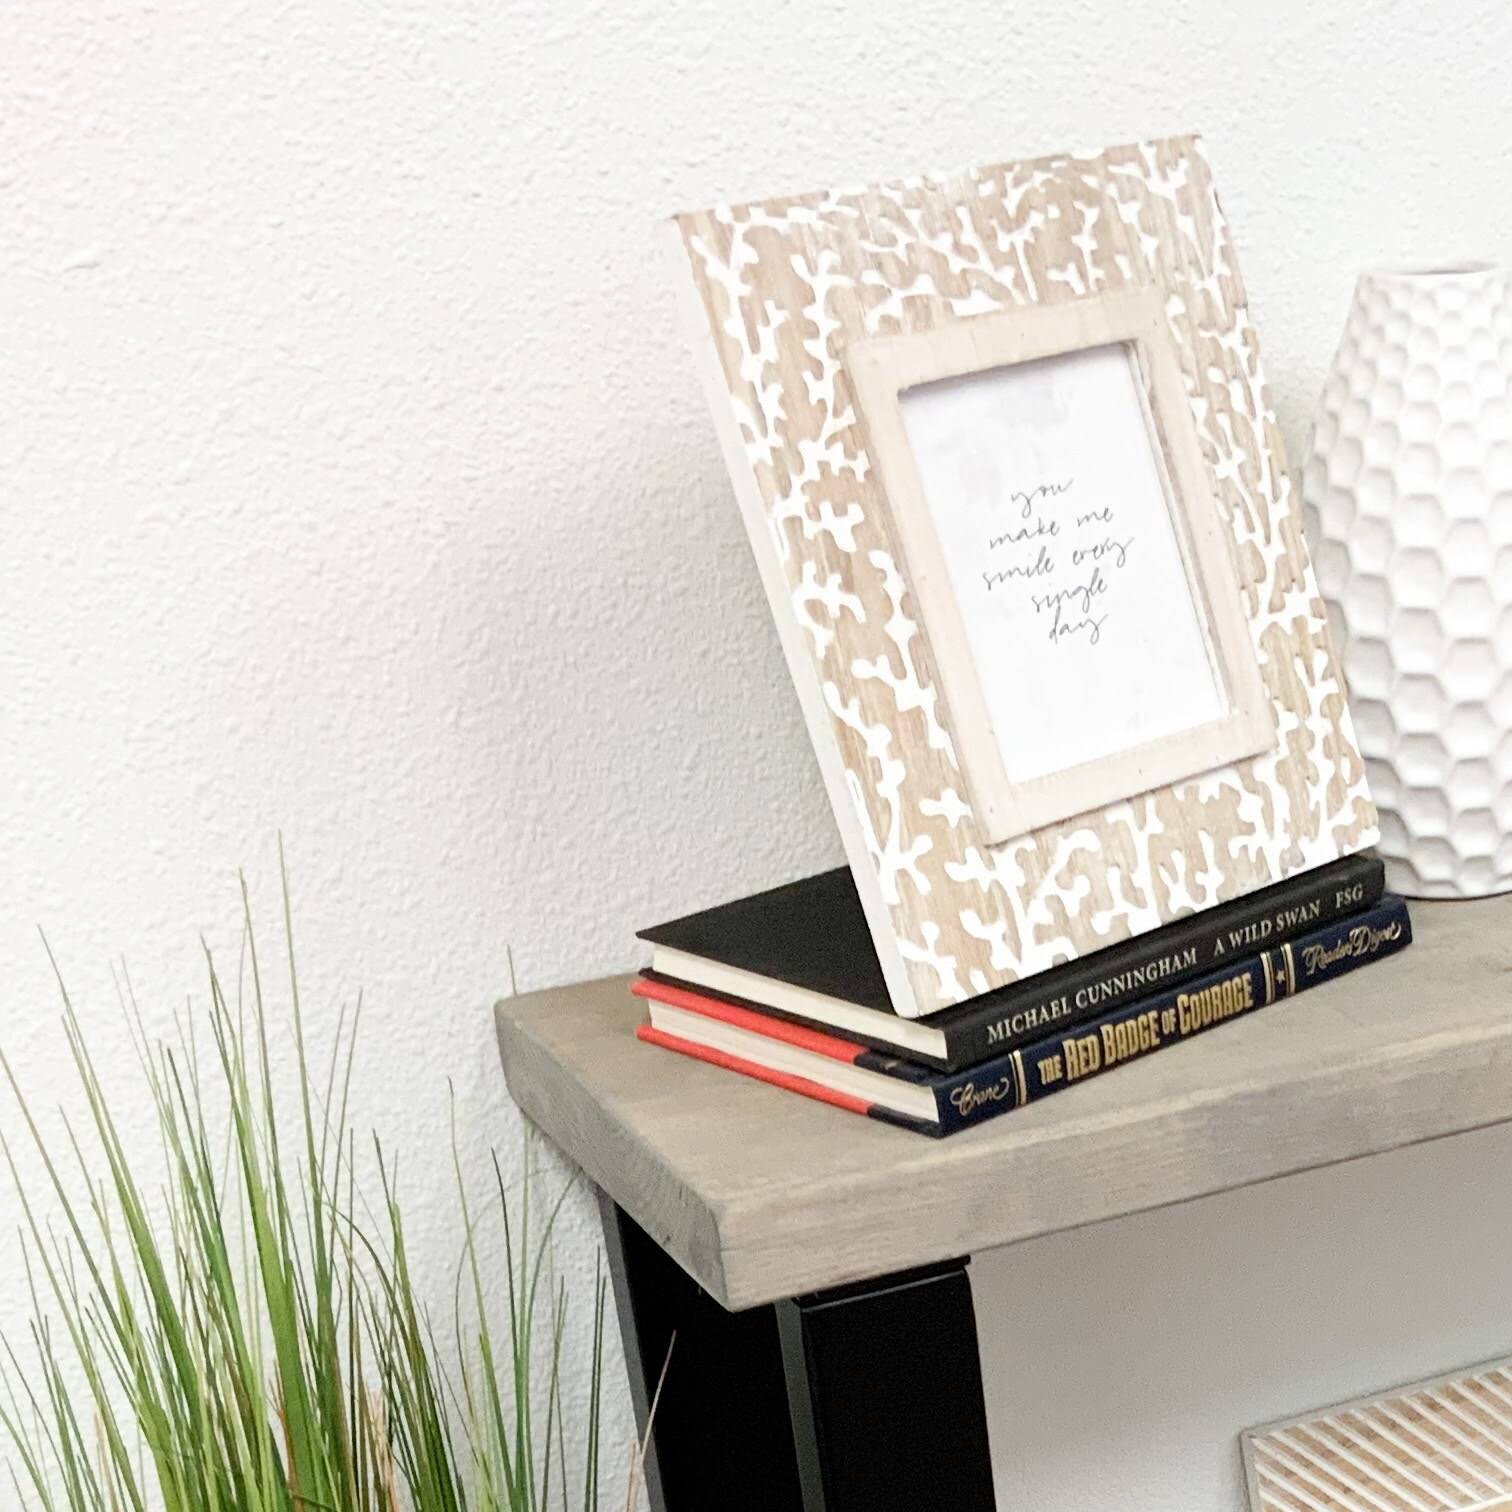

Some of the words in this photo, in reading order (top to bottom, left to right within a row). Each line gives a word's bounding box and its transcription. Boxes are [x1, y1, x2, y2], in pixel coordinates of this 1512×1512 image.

[1010, 478, 1074, 519] you
[989, 516, 1060, 550] make
[1076, 506, 1114, 528] me
[981, 545, 1056, 591] smile
[1071, 537, 1135, 569] every
[1030, 566, 1108, 614] single
[1048, 604, 1109, 646] day
[986, 996, 1072, 1044] MICHAEL
[1075, 947, 1198, 1009] CUNNINGHAM
[1213, 937, 1226, 956] A
[1228, 918, 1272, 949] WILD
[1275, 899, 1321, 933] SWAN
[1335, 883, 1364, 909] FSG
[950, 1077, 1010, 1117] Crane
[1036, 1054, 1063, 1086] THE
[1062, 1033, 1101, 1082] RED
[1100, 1010, 1161, 1066] BADGE
[1161, 1007, 1178, 1035] OF
[1176, 971, 1255, 1035] COURAGE
